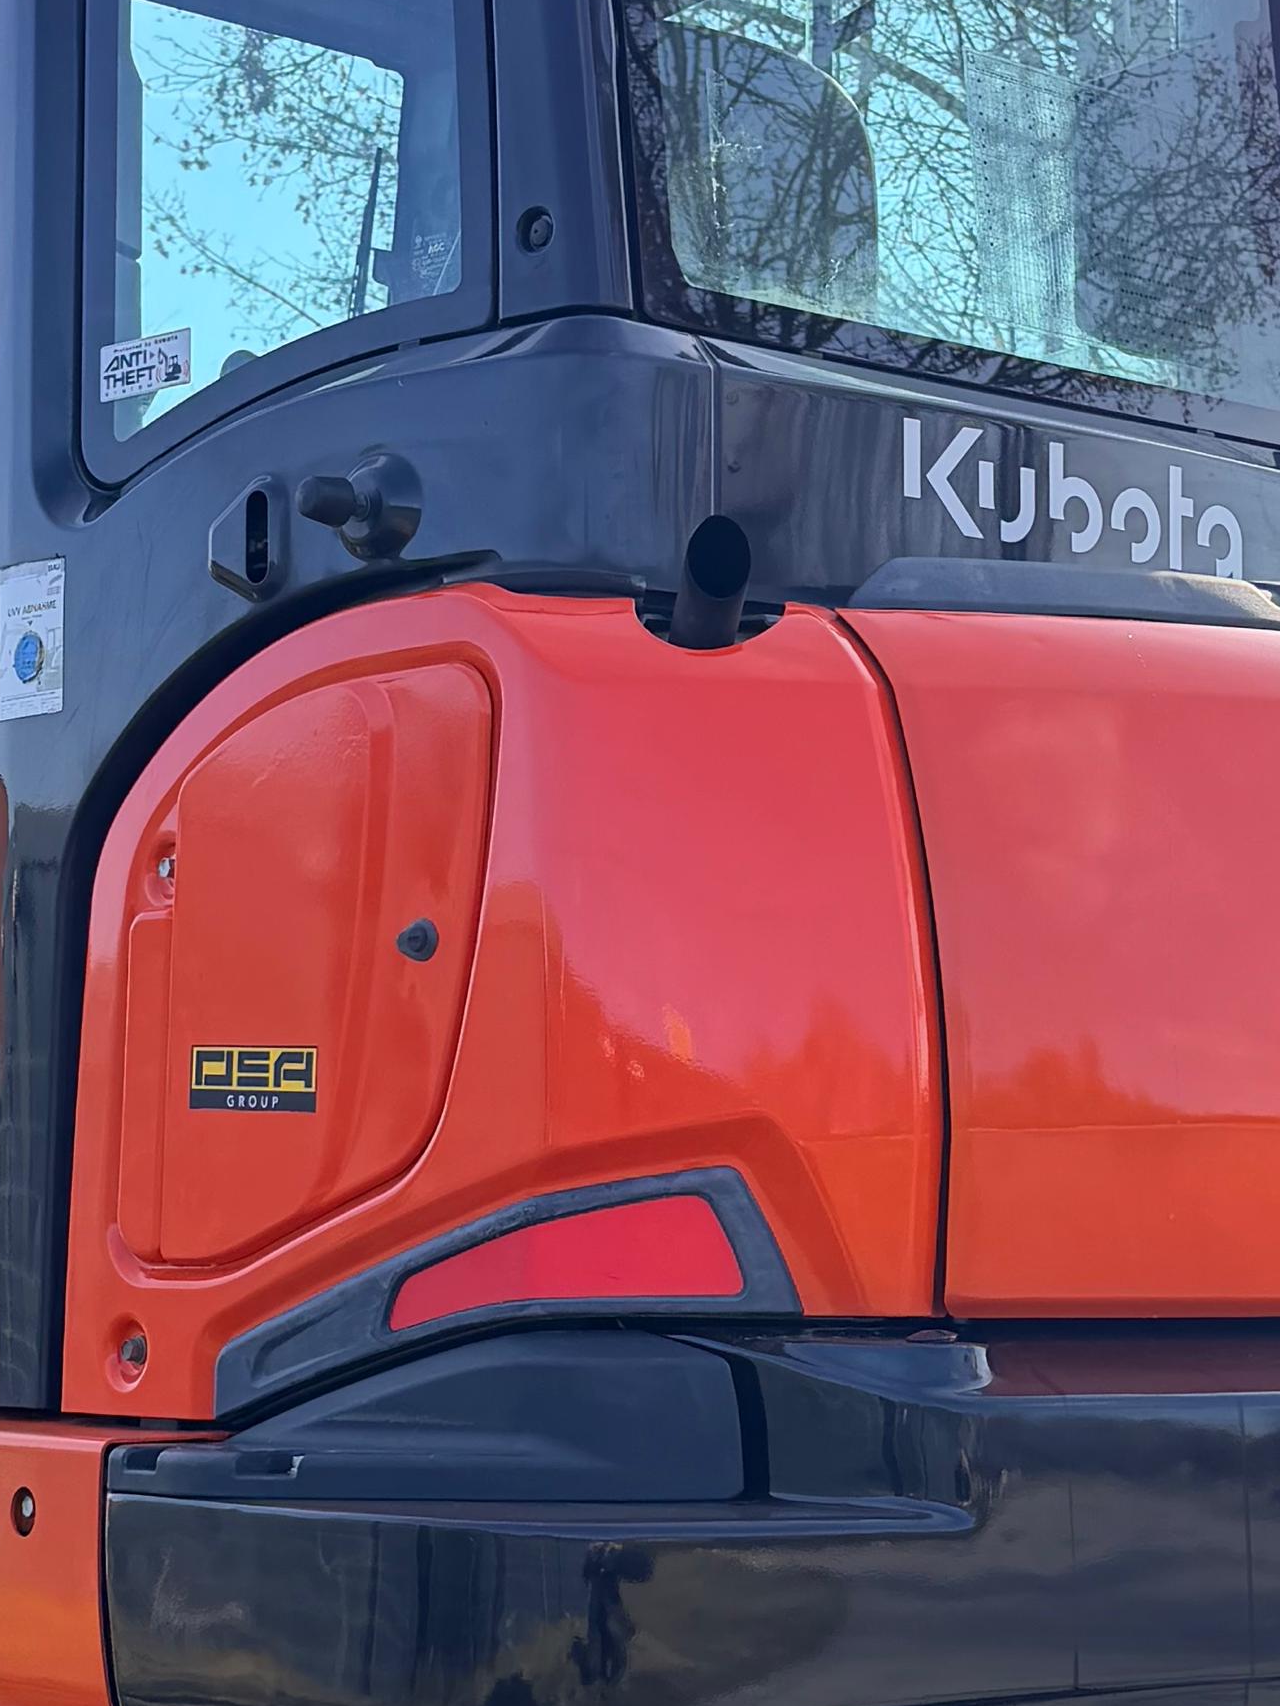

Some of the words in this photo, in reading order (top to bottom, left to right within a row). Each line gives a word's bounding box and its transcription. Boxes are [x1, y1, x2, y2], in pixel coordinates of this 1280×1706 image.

[104, 349, 147, 373] ANTI
[103, 365, 156, 390] THEFT
[903, 417, 1243, 580] Kubota
[226, 1094, 279, 1109] GROUP
